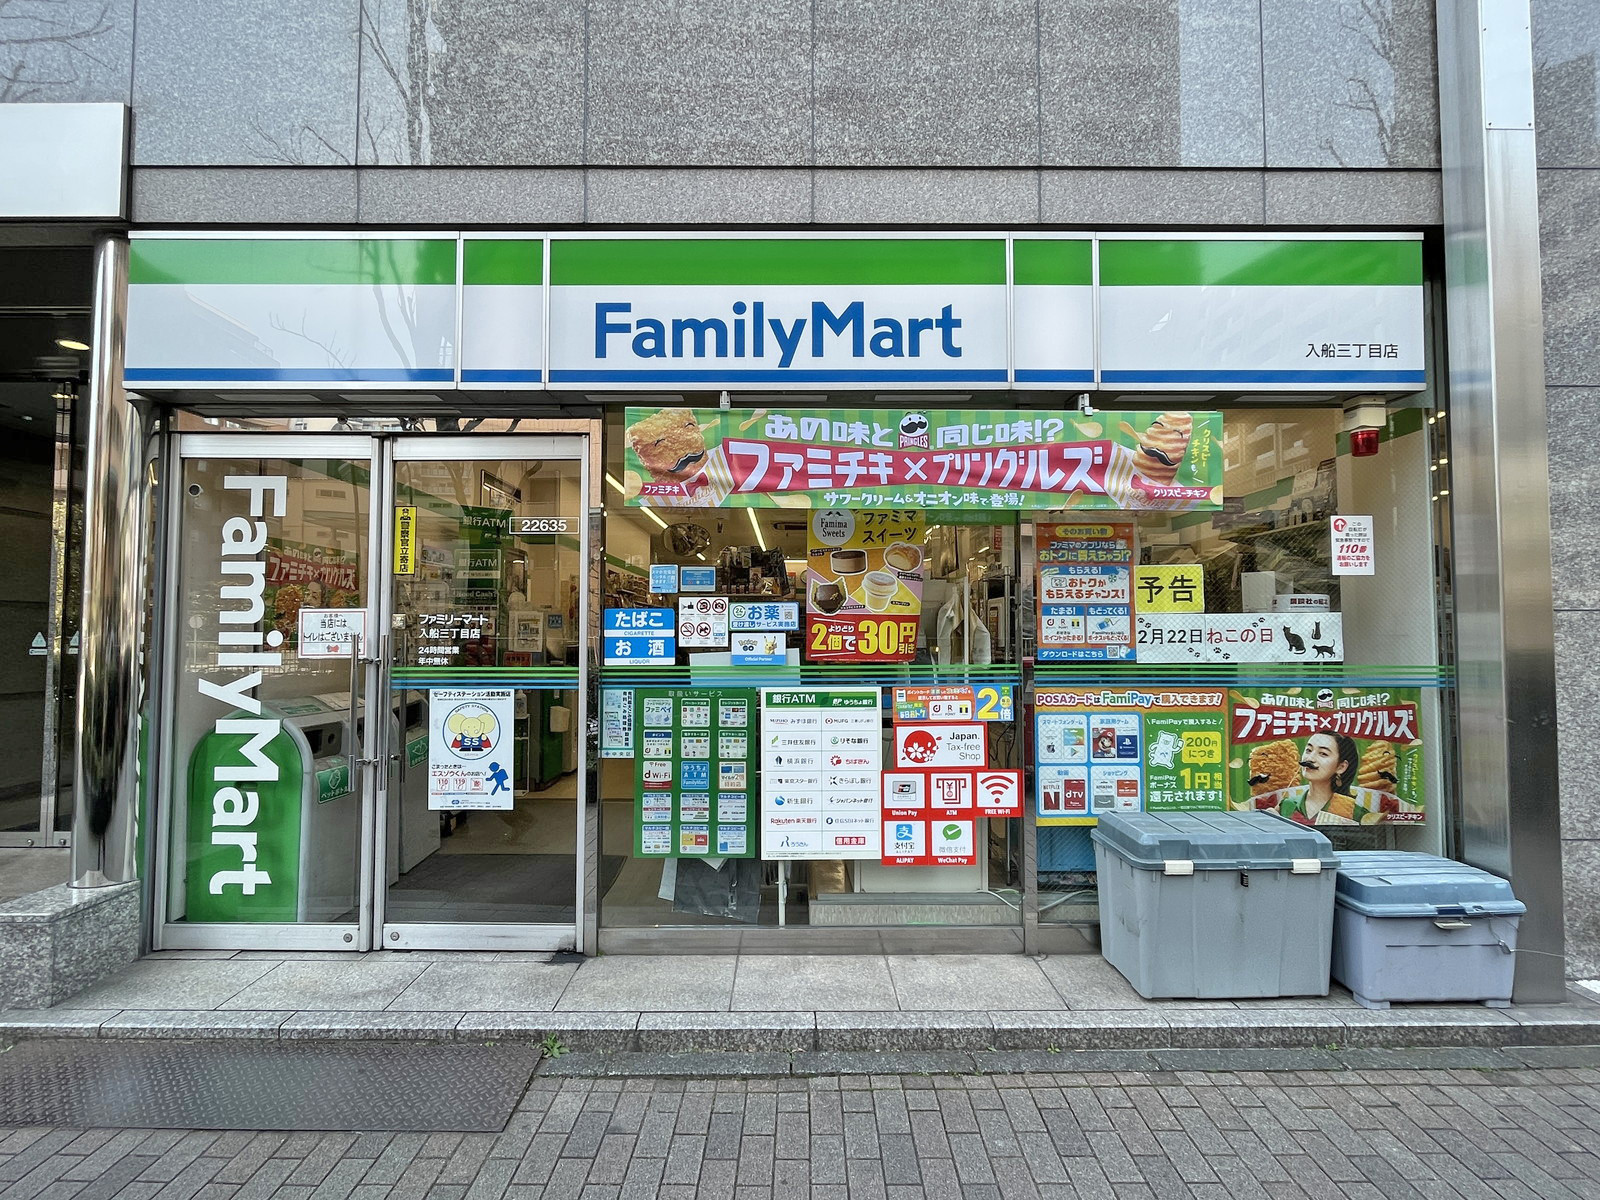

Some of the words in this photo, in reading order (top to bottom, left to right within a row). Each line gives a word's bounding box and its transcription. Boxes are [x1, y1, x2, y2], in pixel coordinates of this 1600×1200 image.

[595, 301, 963, 368] FamilyMart
[1306, 343, 1399, 358] 入船三丁目店
[765, 414, 894, 447] あの味と
[937, 418, 1064, 448] 同じ味!?
[899, 433, 930, 449] PRINGLES
[644, 485, 680, 495] ファミチキ
[1153, 487, 1208, 498] クリスピーチキン
[863, 509, 917, 525] ファミマ
[521, 519, 568, 532] 22635
[820, 518, 848, 528] Famima
[822, 528, 846, 538] Sweets
[862, 527, 917, 544] スイーツ
[1050, 541, 1116, 549] ファミマのアプリなら
[1339, 544, 1367, 554] 110番
[1068, 566, 1102, 574] もらえる!
[1045, 589, 1125, 599] もらえるチャンス!
[1138, 575, 1197, 603] 予告
[748, 605, 780, 621] お薬
[1088, 607, 1127, 615] もどってくる!
[320, 618, 347, 628] 当店には
[418, 614, 488, 625] ファミリーマート
[615, 611, 664, 628] たばこ
[418, 628, 481, 639] 入船三丁目店
[828, 625, 855, 633] よりどり
[1138, 628, 1203, 645] 2月22日
[1206, 627, 1273, 644] ねこの日
[418, 646, 460, 655] 24時間営業
[418, 657, 449, 665] 年中無休
[198, 475, 287, 896] FamilyMart
[772, 694, 816, 704] 銀行ATM
[977, 688, 999, 719] 2
[1000, 708, 1011, 720] 倍
[1260, 693, 1315, 709] あの味と
[1336, 693, 1390, 709] 同じ味!?
[949, 732, 980, 741] Japan.
[464, 738, 480, 746] SS
[946, 742, 981, 751] Tax-free
[1186, 737, 1218, 747] 200円
[958, 752, 981, 761] Shop
[1188, 749, 1215, 758] につき
[1149, 774, 1177, 782] FamiPay
[1149, 781, 1177, 789] ボーナス
[1149, 790, 1223, 803] 還元されます!
[908, 809, 917, 817] Pay
[835, 837, 866, 845] 信用金庫
[894, 841, 915, 849] 支付宝
[938, 846, 966, 854] 微信支付
[957, 857, 968, 865] Pay
